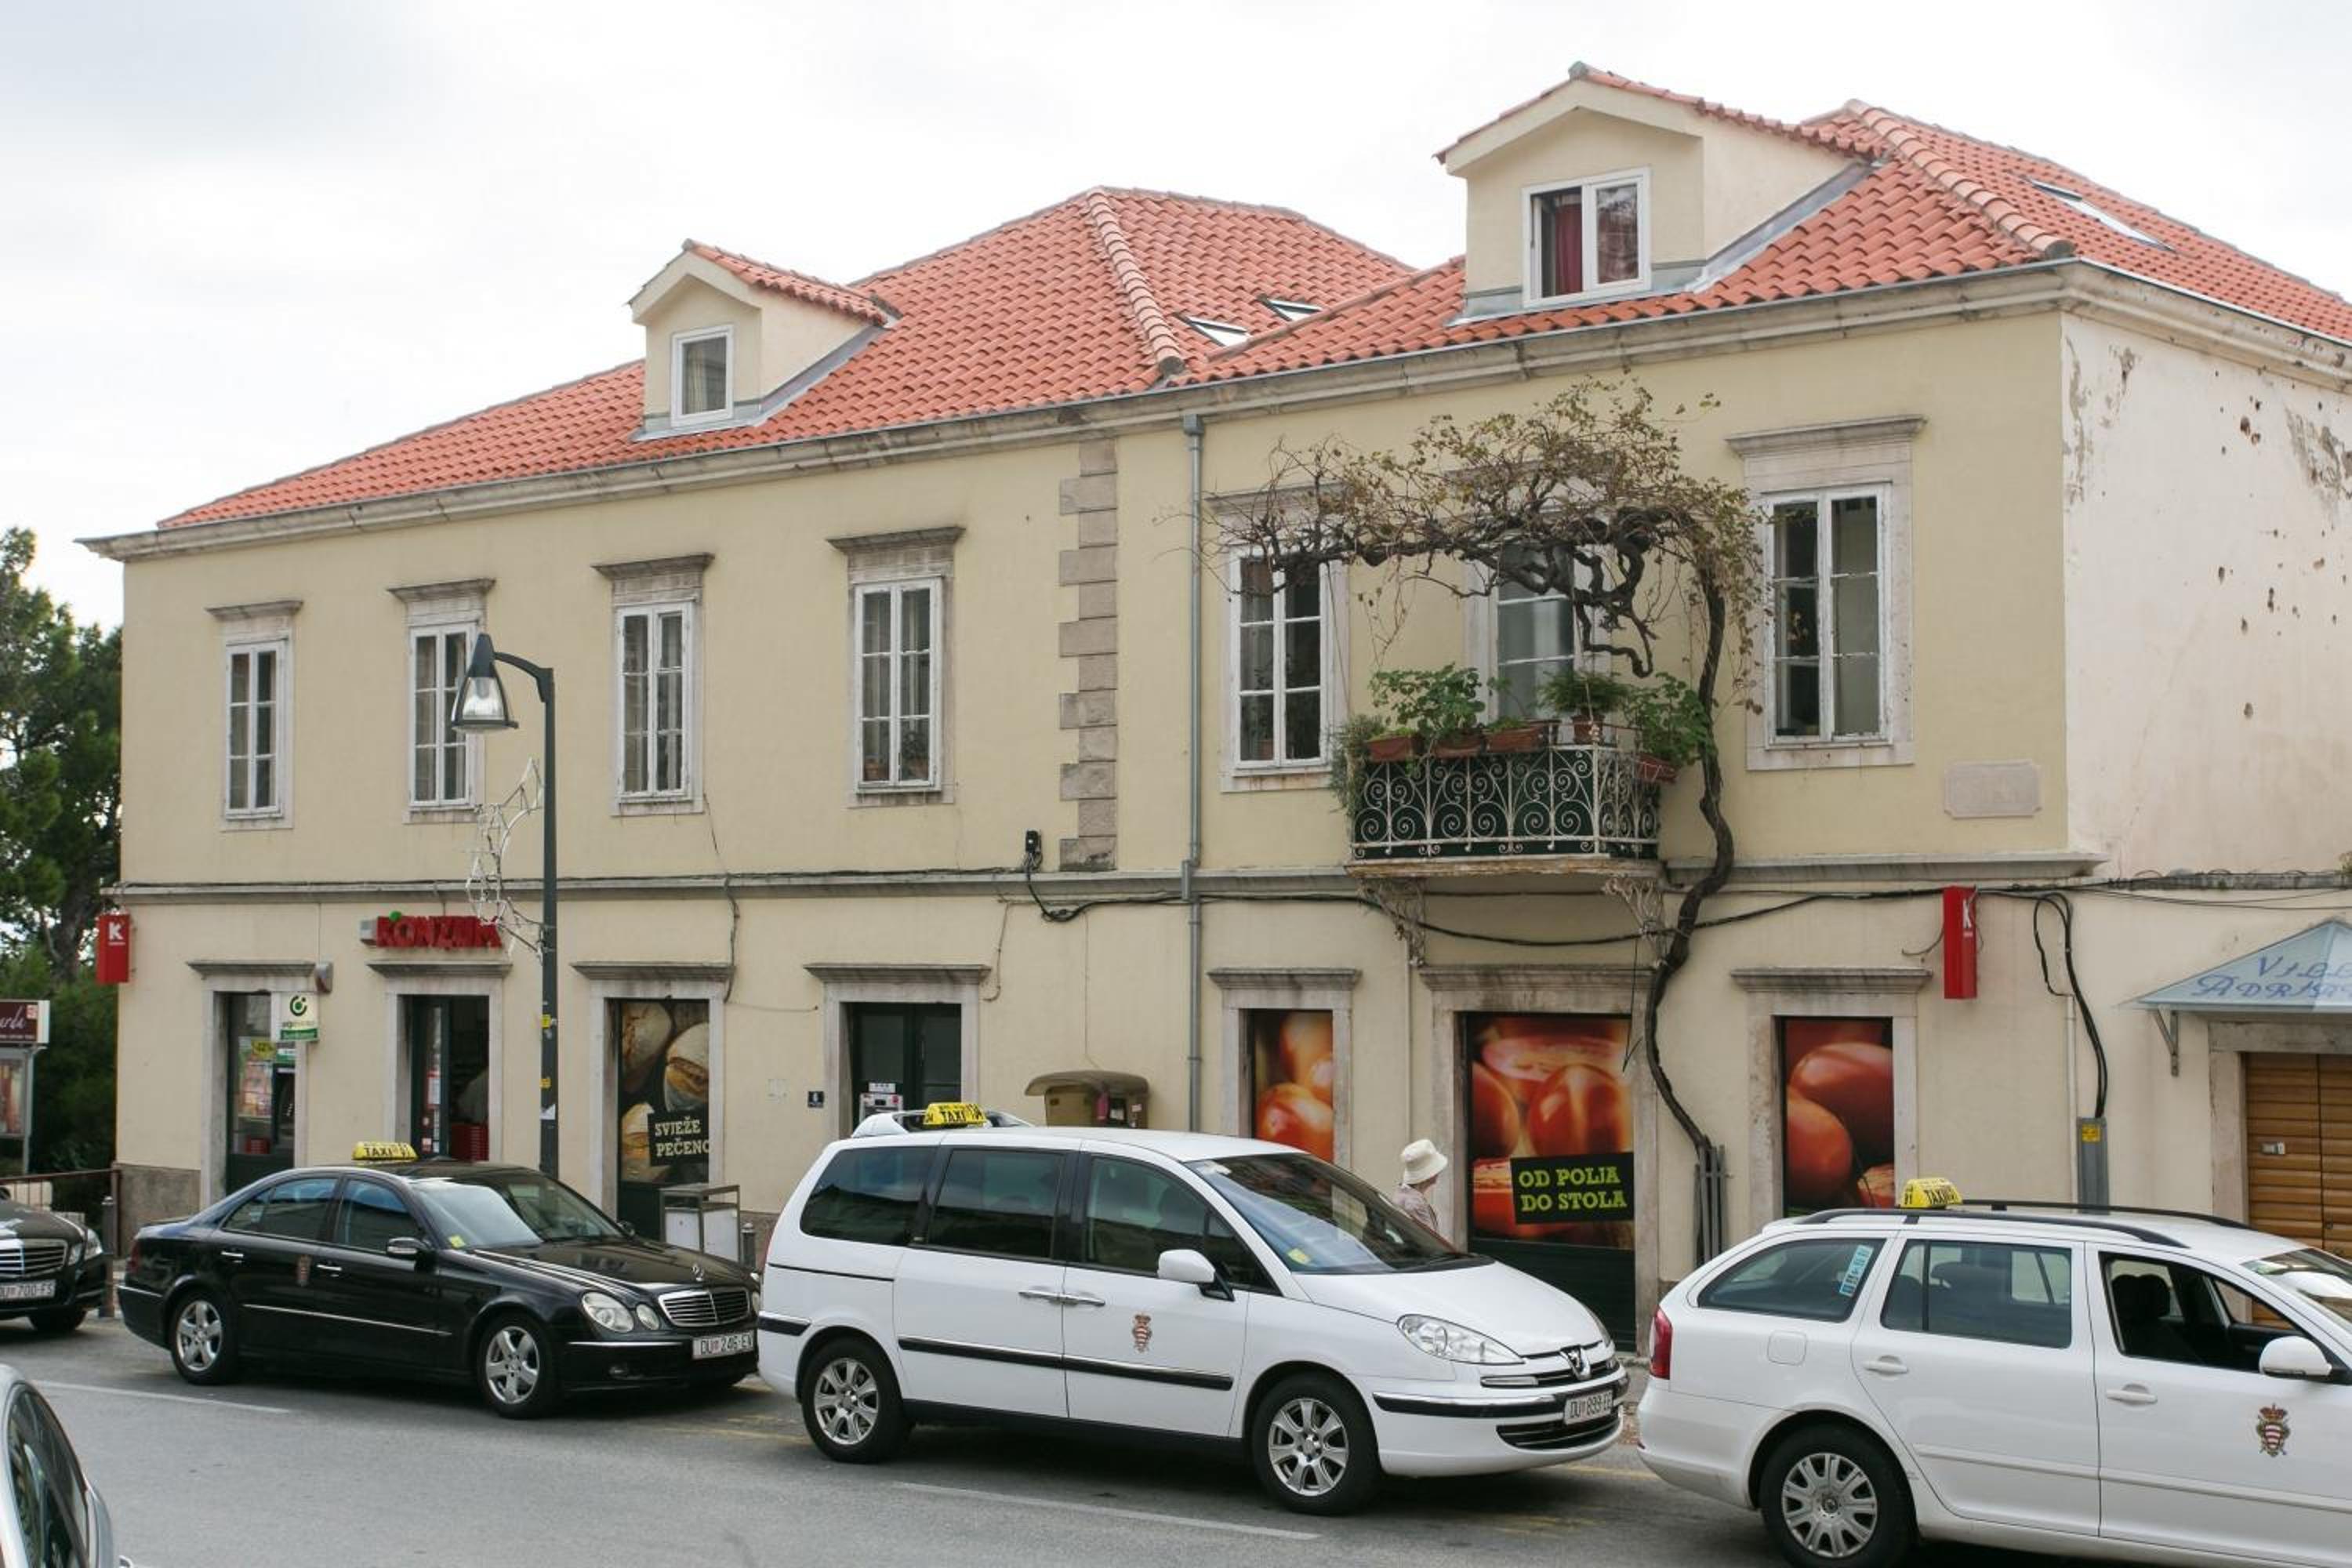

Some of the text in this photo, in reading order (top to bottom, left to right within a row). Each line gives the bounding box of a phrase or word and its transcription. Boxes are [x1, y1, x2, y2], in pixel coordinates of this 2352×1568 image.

[108, 921, 124, 941] K
[654, 1116, 702, 1137] SVJEŽE
[940, 1110, 968, 1123] TAXI
[363, 1146, 393, 1157] TAXI
[1519, 1166, 1621, 1188] OD POLJA
[1520, 1189, 1628, 1212] DO STOLA
